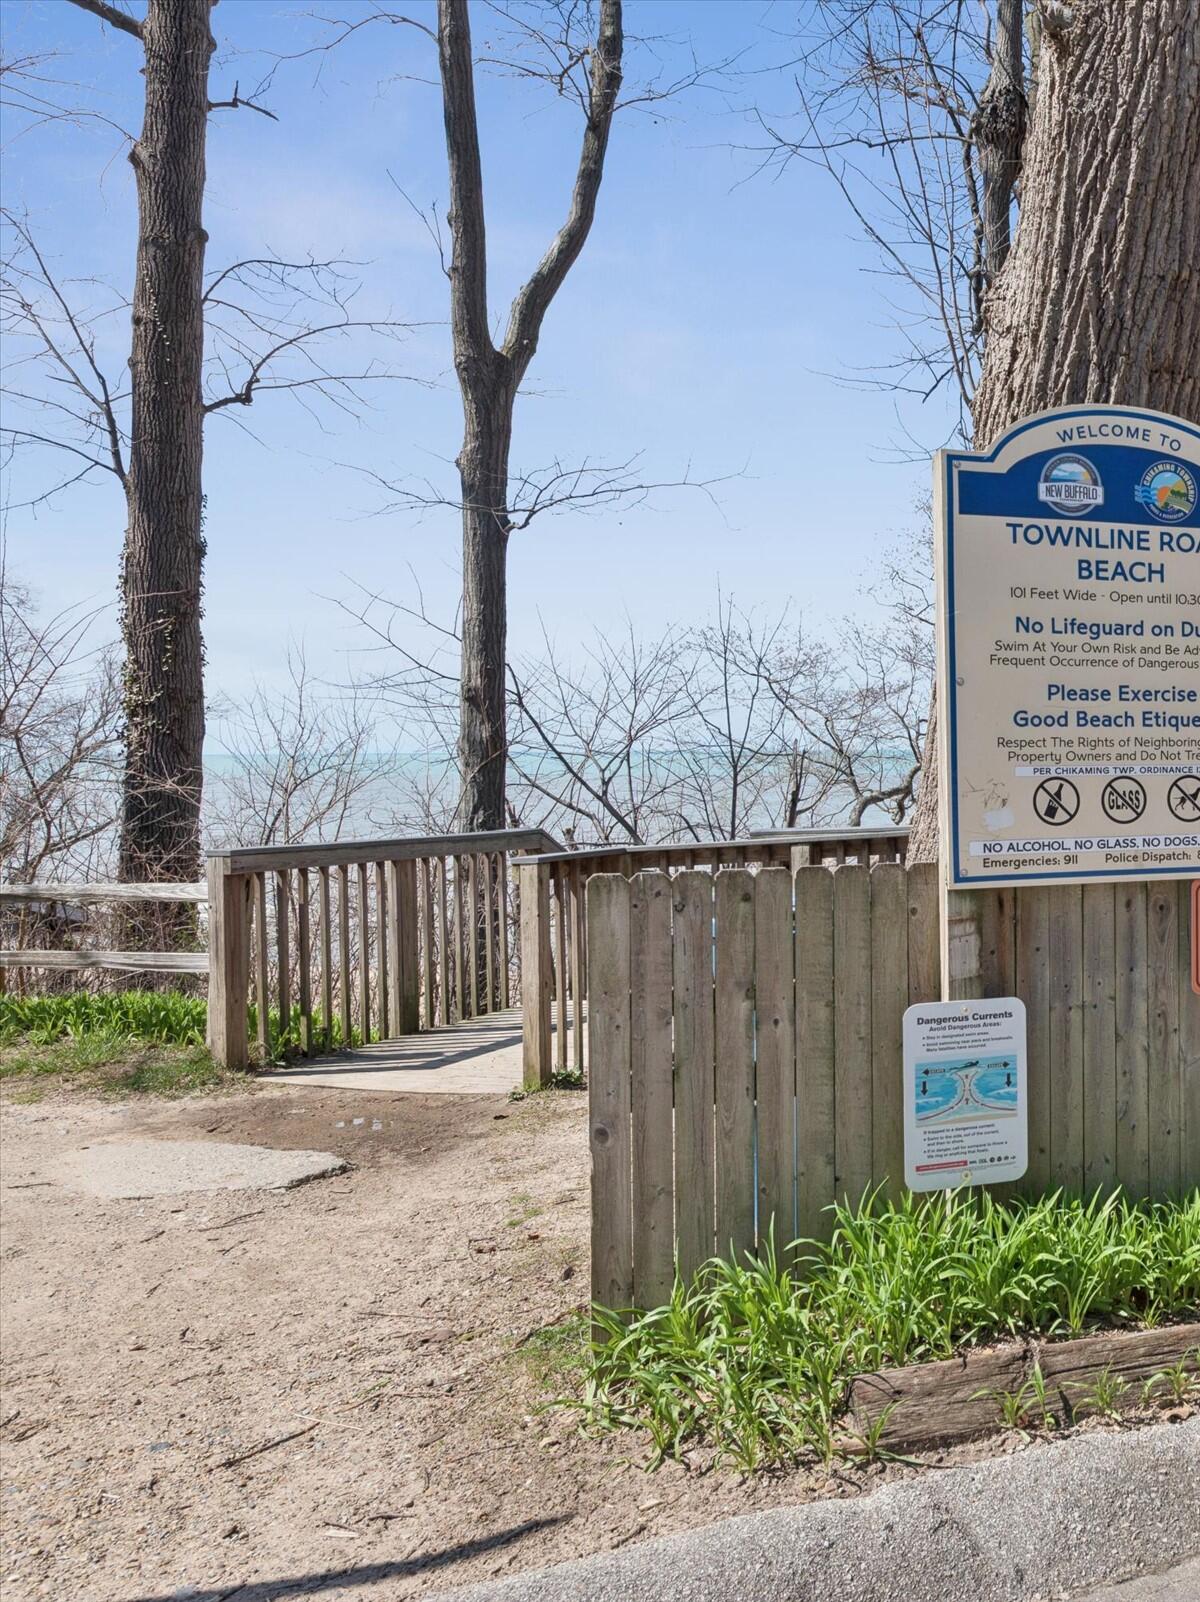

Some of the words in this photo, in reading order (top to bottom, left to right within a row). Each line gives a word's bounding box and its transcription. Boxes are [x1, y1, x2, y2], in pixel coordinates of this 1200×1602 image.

[1056, 424, 1150, 444] WELCOME
[1160, 434, 1181, 452] TO
[1046, 484, 1062, 497] NEW
[1065, 485, 1097, 500] BUFFALO
[1006, 523, 1150, 550] TOWNLINE
[1078, 560, 1165, 583] BEACH
[1031, 588, 1059, 600] Feet
[1063, 589, 1096, 602] Wide
[1110, 592, 1143, 605] Open
[1147, 593, 1172, 604] until
[1016, 617, 1043, 634] No
[1051, 619, 1144, 640] Lifeguard
[1152, 625, 1174, 637] on
[995, 640, 1029, 653] Swim
[1032, 642, 1046, 652] At
[1049, 642, 1077, 653] Your
[1081, 643, 1109, 654] Own
[1114, 643, 1136, 654] Risk
[1140, 644, 1161, 655] and
[1165, 646, 1180, 655] Be
[990, 655, 1045, 669] Frequent
[1053, 656, 1118, 668] Occurrence
[1122, 657, 1134, 668] of
[1138, 658, 1199, 672] Dangerous
[1047, 684, 1111, 702] Please
[1119, 686, 1198, 702] Exercise
[1013, 710, 1068, 728] Good
[1076, 711, 1134, 728] Beach
[997, 737, 1046, 751] Respect
[1050, 737, 1074, 748] The
[1078, 737, 1115, 751] Rights
[1118, 737, 1130, 748] of
[1008, 751, 1061, 765] Property
[1066, 751, 1110, 761] Owners
[1115, 750, 1137, 761] and
[1140, 750, 1157, 761] Do
[1160, 750, 1181, 760] Not
[1055, 767, 1110, 775] CHIKAMING
[1139, 766, 1193, 774] ORDINANCE
[1108, 790, 1141, 810] GLASS
[983, 843, 1003, 853] NO
[1074, 840, 1093, 850] NO
[1142, 837, 1160, 848] NO
[983, 856, 1061, 870] Emergencies:
[1064, 854, 1078, 865] 911
[1105, 853, 1138, 864] Police
[1141, 851, 1192, 863] Dispatch:
[917, 1015, 969, 1026] Dangerous
[972, 1011, 1013, 1021] Currents
[948, 1023, 981, 1031] Dangerous
